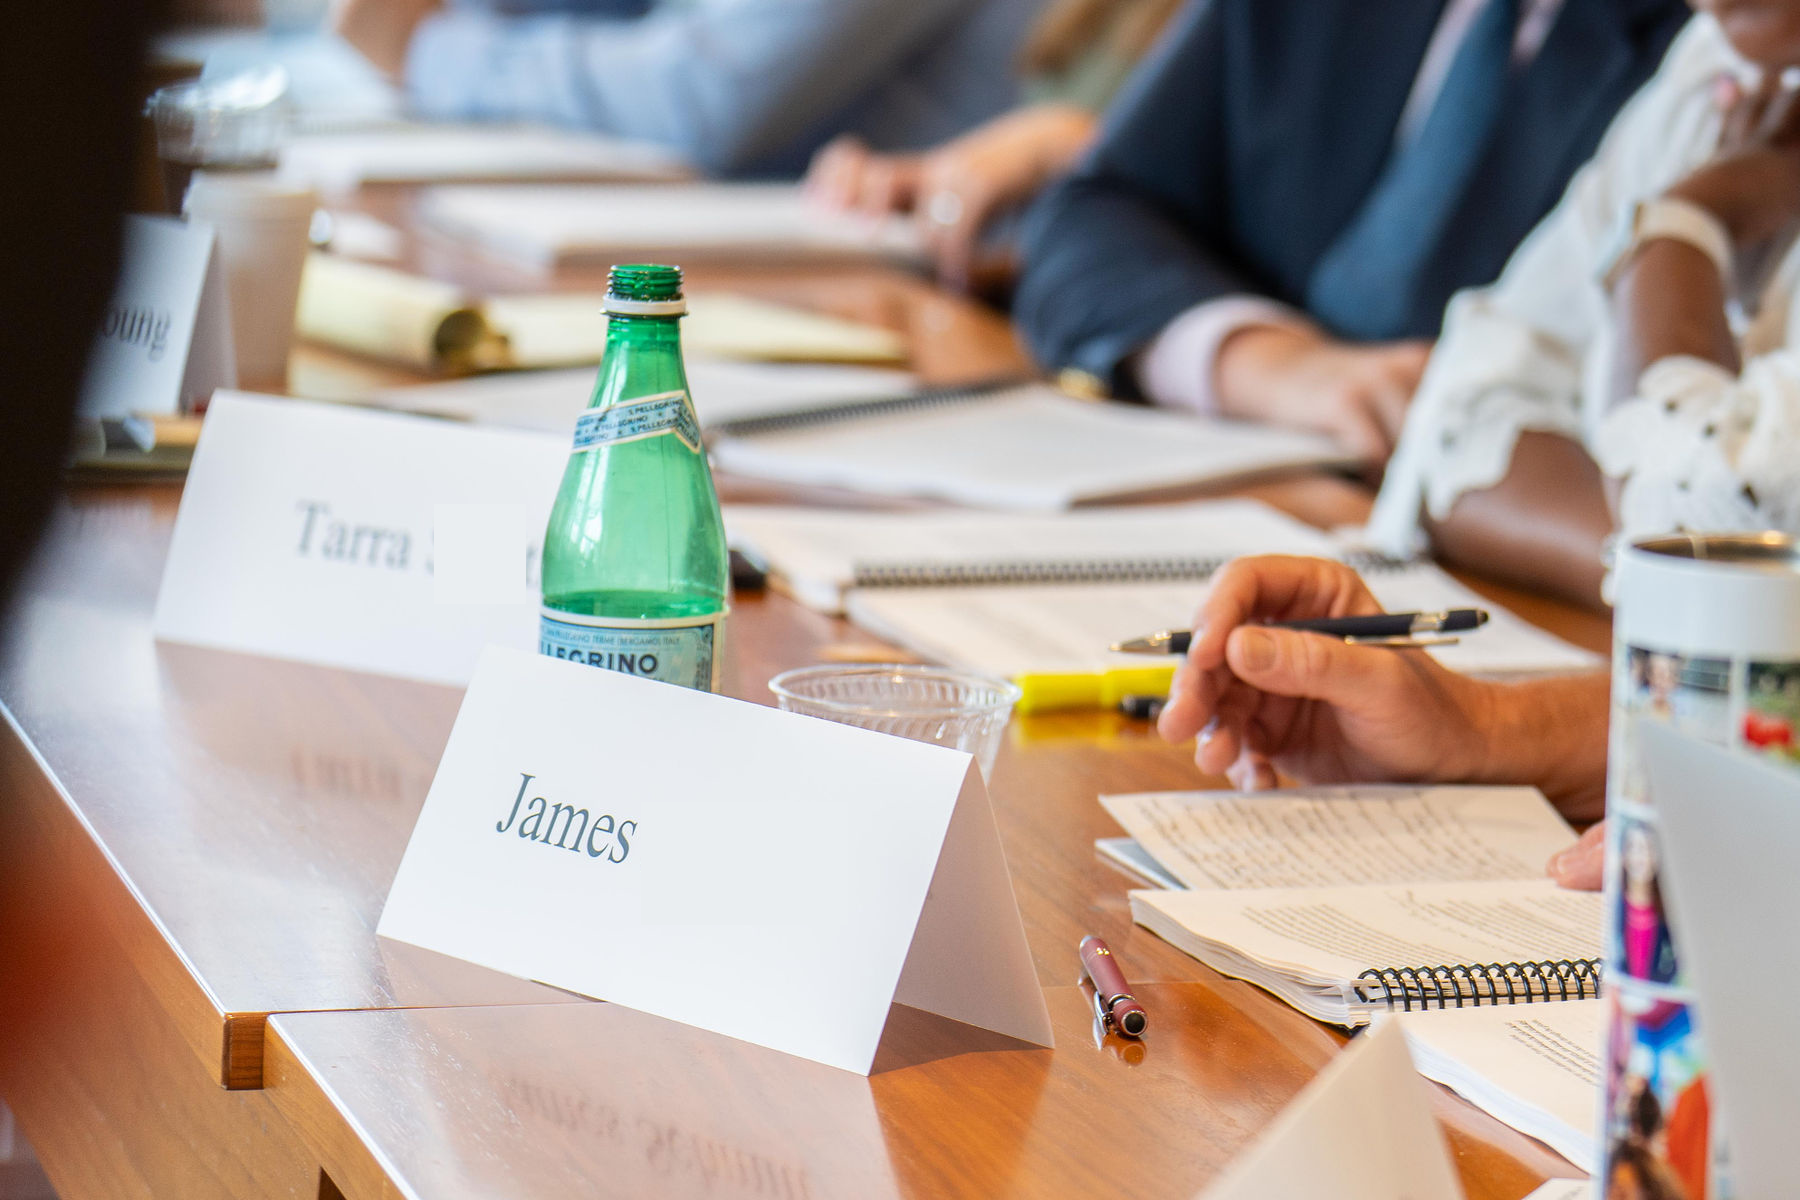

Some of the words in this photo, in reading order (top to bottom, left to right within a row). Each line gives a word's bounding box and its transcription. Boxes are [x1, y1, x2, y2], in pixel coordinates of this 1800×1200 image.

[102, 308, 171, 363] oung
[295, 498, 413, 571] Tarra
[496, 772, 638, 864] James
